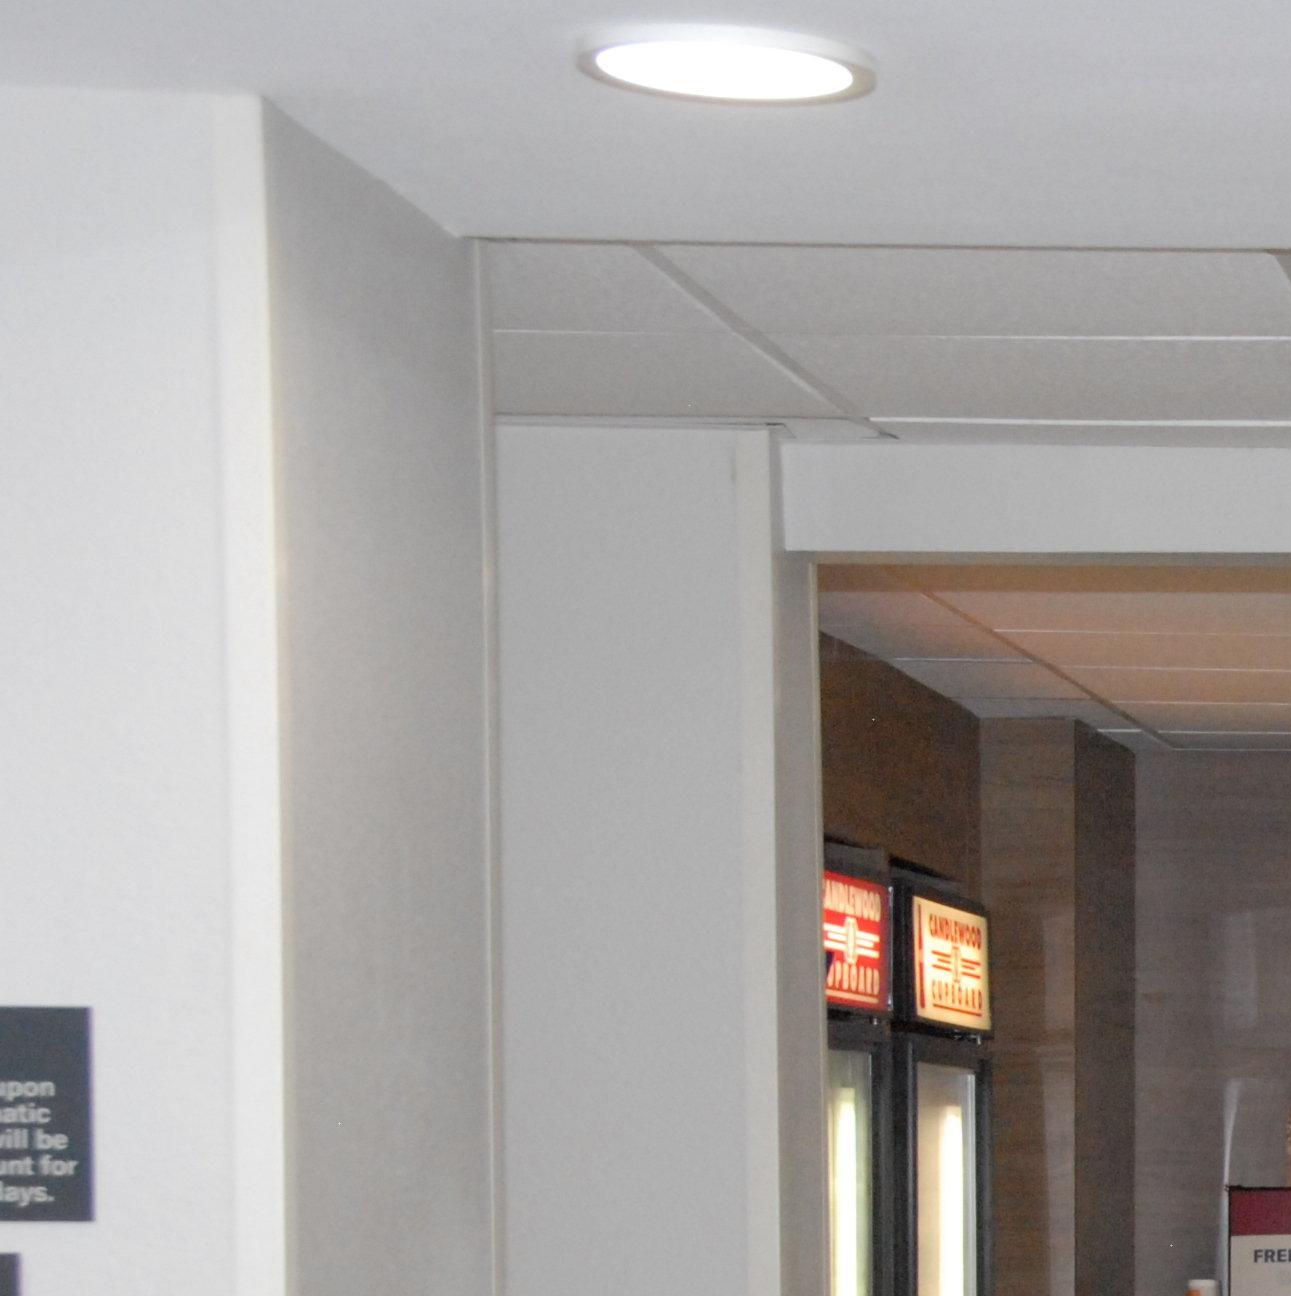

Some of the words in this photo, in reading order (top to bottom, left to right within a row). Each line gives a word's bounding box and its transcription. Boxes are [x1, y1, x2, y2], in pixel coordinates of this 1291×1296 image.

[929, 913, 982, 950] CANDLEWOOD
[932, 979, 983, 1010] CUPBOARD
[0, 1102, 51, 1123] atic
[36, 1128, 69, 1150] be
[40, 1154, 79, 1176] for
